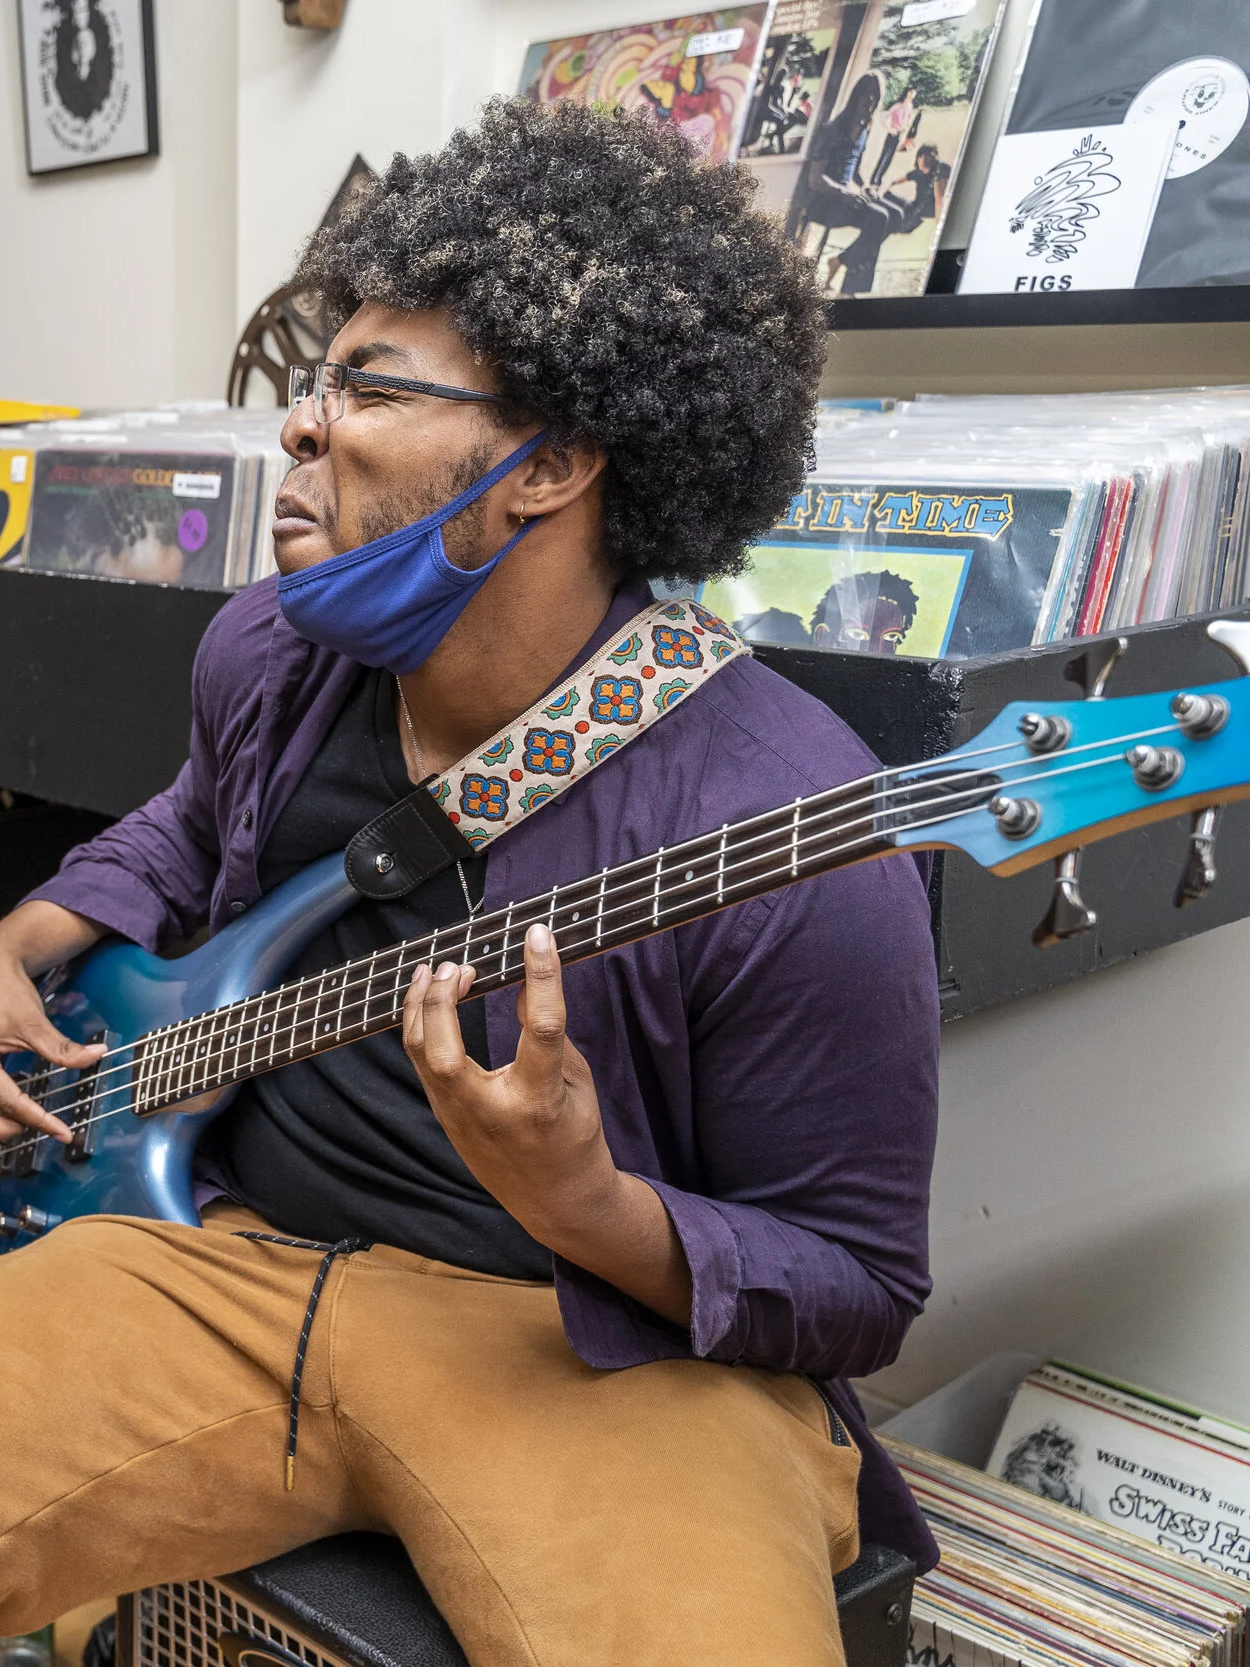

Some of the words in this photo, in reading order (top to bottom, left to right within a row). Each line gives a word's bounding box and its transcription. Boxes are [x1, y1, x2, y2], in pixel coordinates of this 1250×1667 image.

[1014, 274, 1072, 292] FIGS
[809, 492, 879, 532] IN
[874, 491, 1014, 541] TIME
[1096, 1449, 1139, 1474] WALT
[1140, 1468, 1212, 1503] DISNEY'S
[1218, 1499, 1246, 1517] STORY
[1109, 1483, 1210, 1544] SWISS
